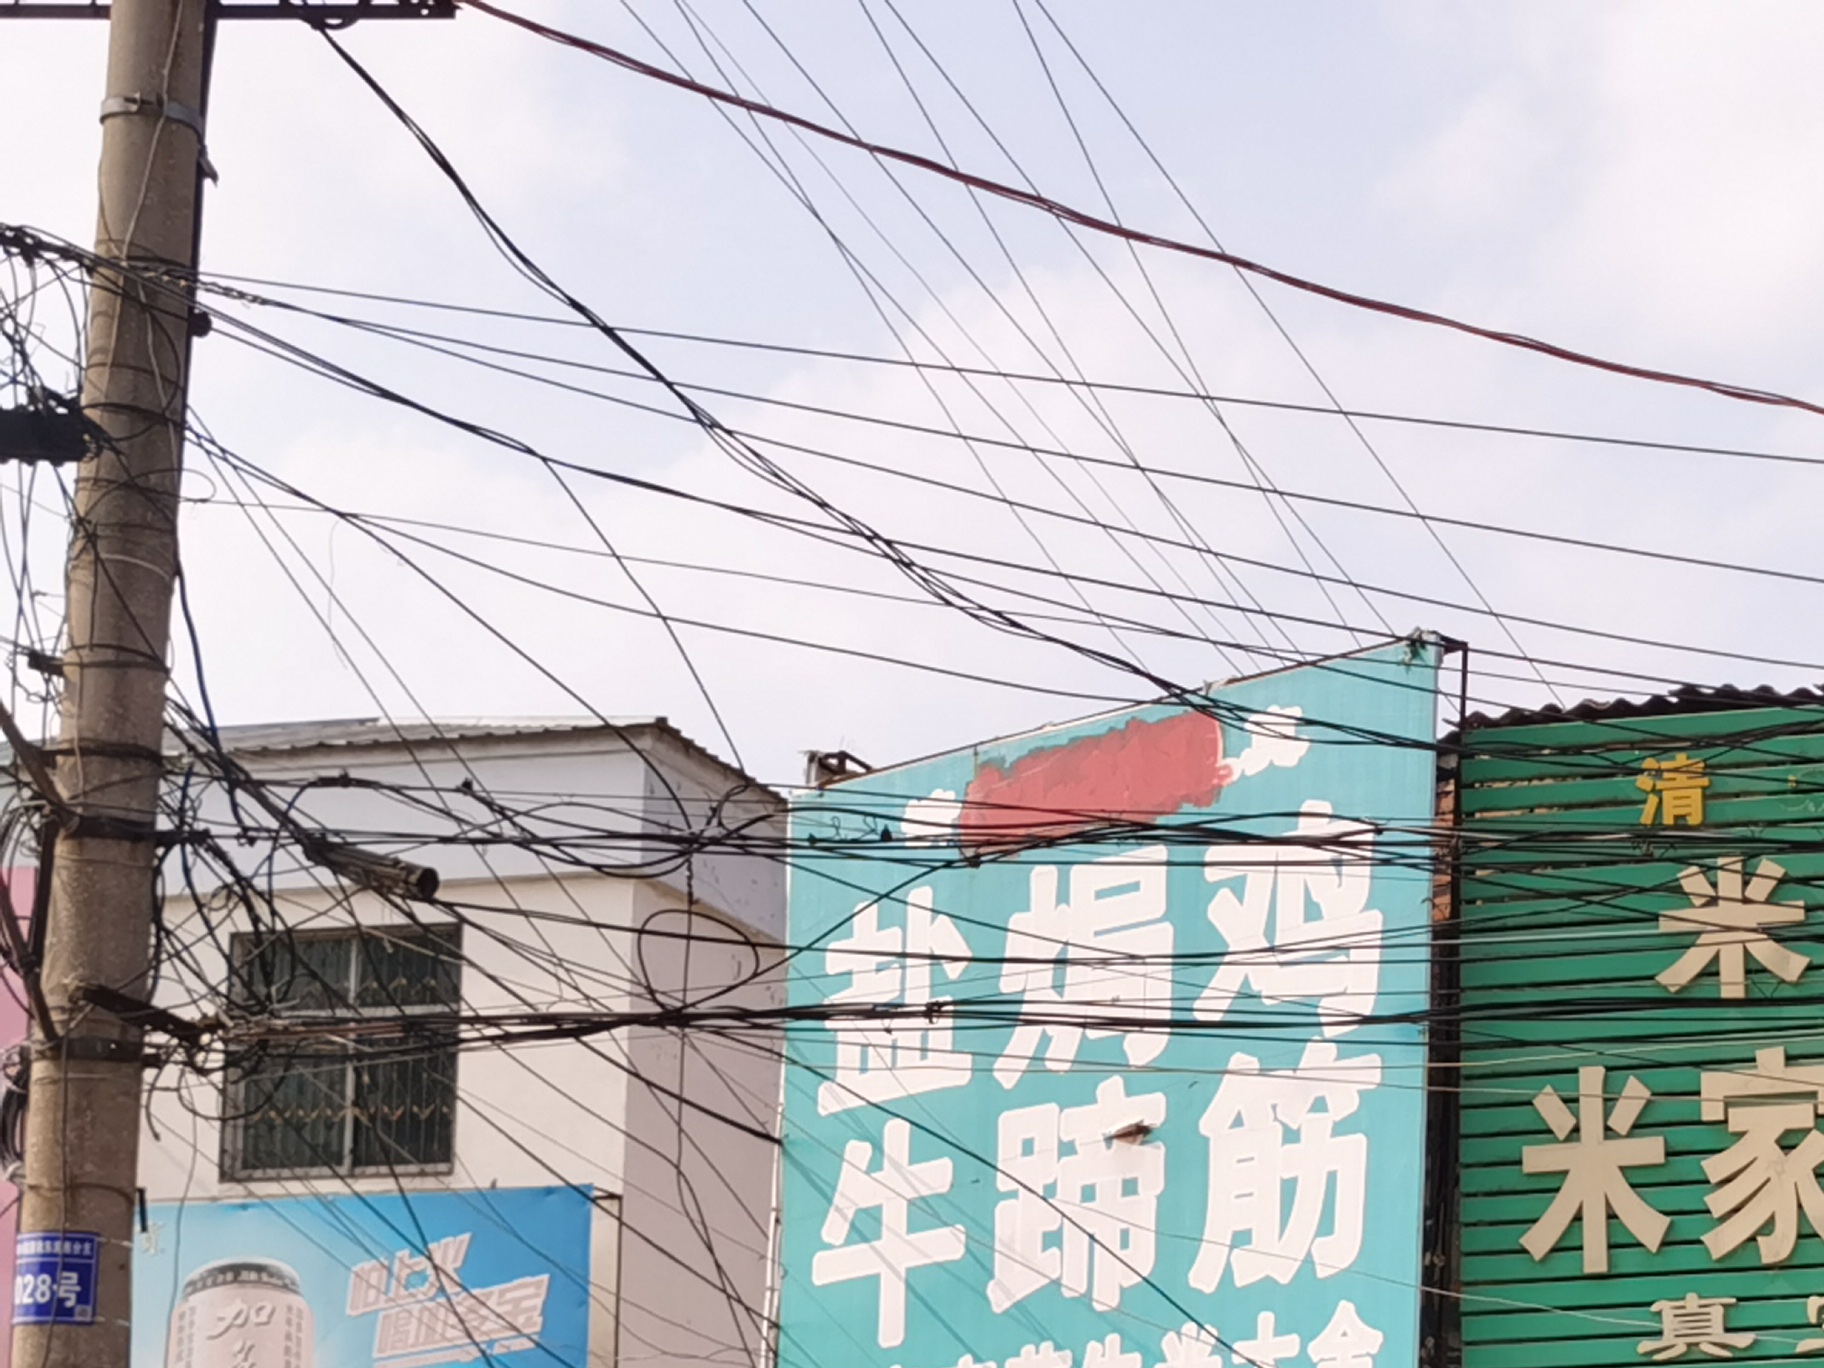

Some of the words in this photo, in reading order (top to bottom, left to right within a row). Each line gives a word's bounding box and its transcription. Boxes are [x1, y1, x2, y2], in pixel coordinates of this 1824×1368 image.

[1637, 754, 1709, 827] 清
[818, 799, 1384, 1117] 盐焗鸡
[812, 1037, 1383, 1349] 牛蹄筋
